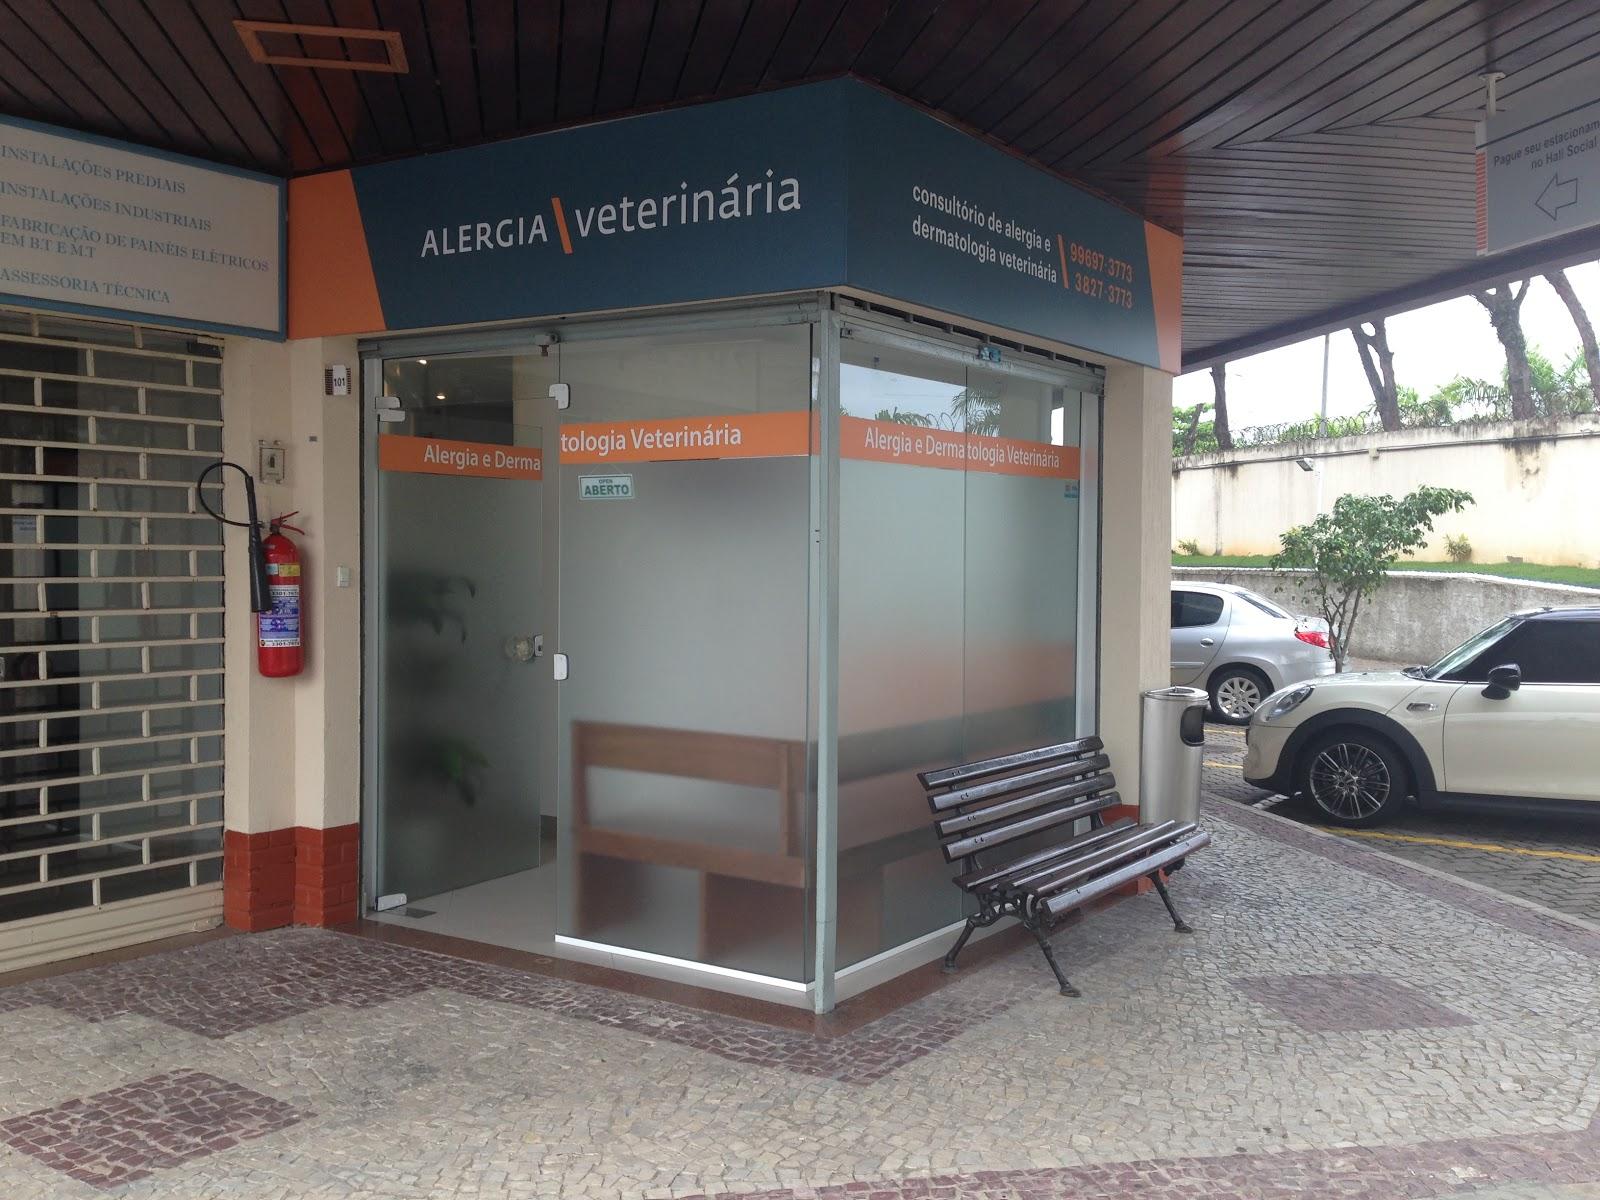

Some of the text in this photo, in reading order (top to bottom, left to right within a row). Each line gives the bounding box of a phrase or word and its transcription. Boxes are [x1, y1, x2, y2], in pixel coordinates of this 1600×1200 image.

[1525, 143, 1541, 155] seu
[1532, 159, 1543, 169] no
[1567, 136, 1597, 157] Social
[1, 145, 186, 193] INSTALAÇÕES PREDIAIS
[0, 181, 211, 231] INSTALAÇÕES INDUSTRIAIS
[421, 168, 801, 257] ALERGIA veterinária
[912, 185, 1051, 253] consultório de alergia e
[0, 214, 269, 272] FABRICAÇÃO DE PAINÉIS ELÉTRICOS
[0, 231, 25, 248] EM
[57, 241, 67, 255] E
[912, 215, 1057, 284] dermatologia veterinária
[0, 267, 170, 303] ASSESSORIA TÉCNICA
[334, 377, 345, 387] 101
[424, 444, 541, 471] Alergia e Derma
[561, 423, 742, 456] tologia Veterinária
[865, 427, 912, 457] Alergia
[915, 438, 922, 450] e
[1007, 446, 1060, 468] Veterinária
[584, 484, 629, 496] ABERTO
